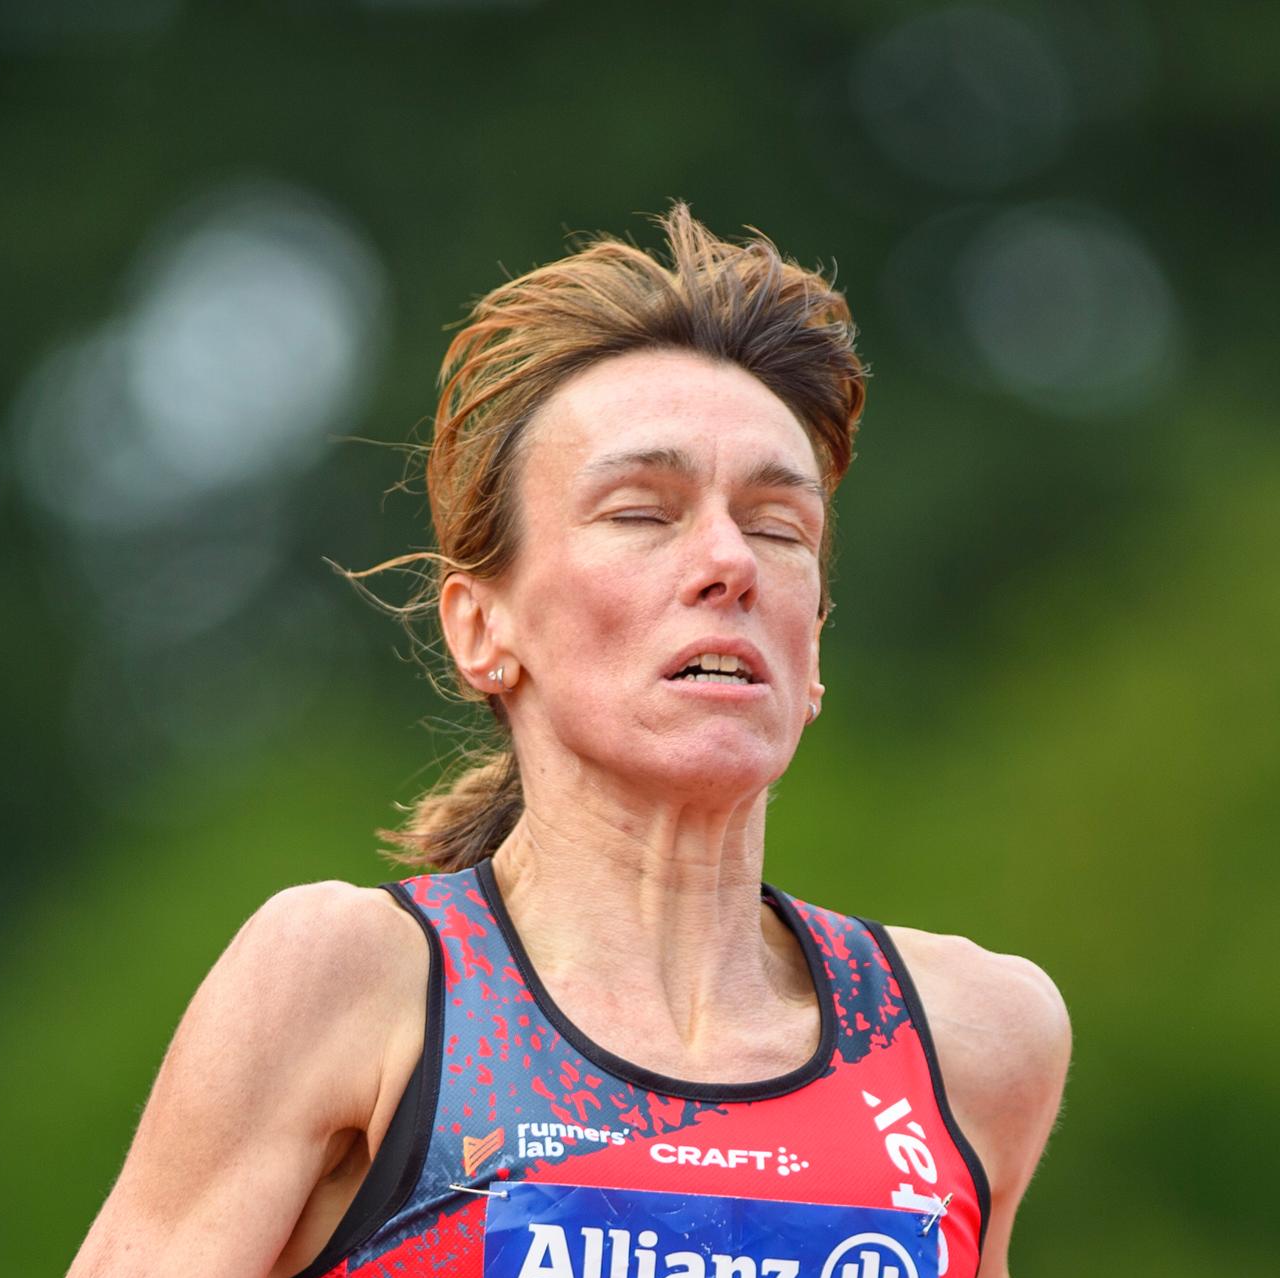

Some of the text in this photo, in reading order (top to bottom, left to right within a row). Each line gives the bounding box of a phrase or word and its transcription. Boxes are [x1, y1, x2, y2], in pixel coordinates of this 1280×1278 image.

[517, 1122, 629, 1146] runners'
[517, 1137, 565, 1158] lab
[649, 1143, 773, 1171] CRAFT
